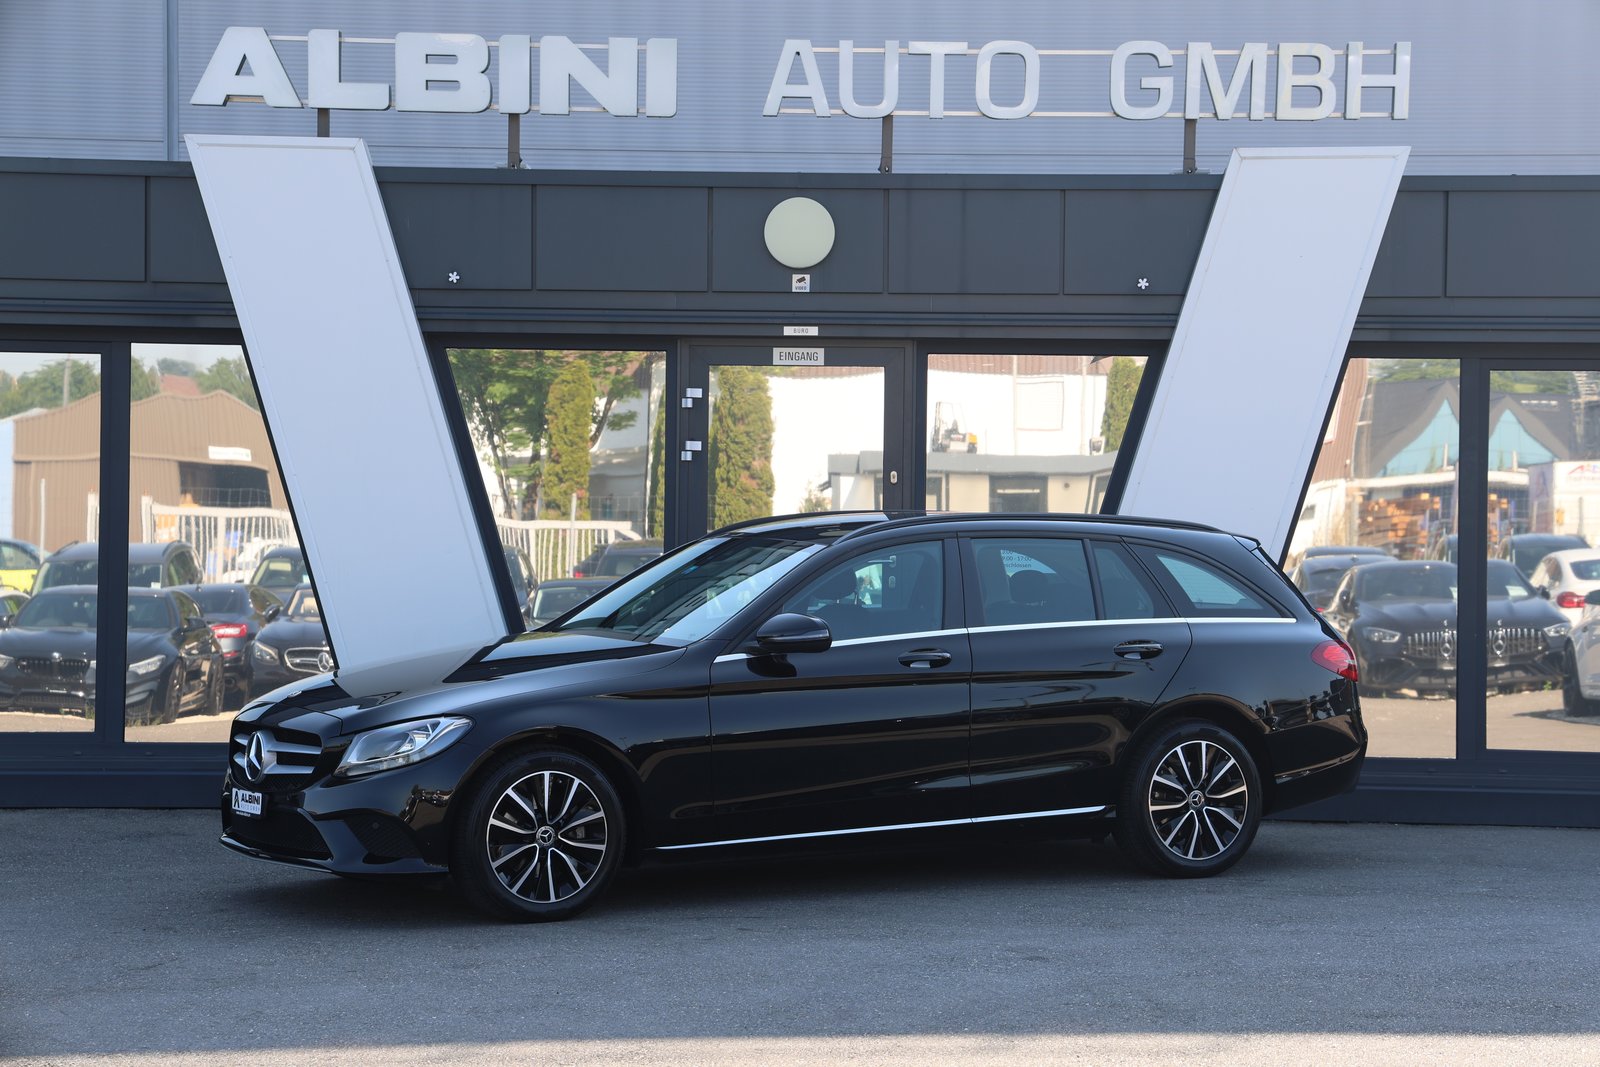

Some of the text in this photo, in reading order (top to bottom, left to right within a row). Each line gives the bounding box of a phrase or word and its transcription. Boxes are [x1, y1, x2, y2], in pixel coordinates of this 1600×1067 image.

[190, 26, 1412, 121] ALBINI AUTO GMBH
[779, 351, 819, 361] EINGANG
[241, 793, 260, 805] ALBINI
